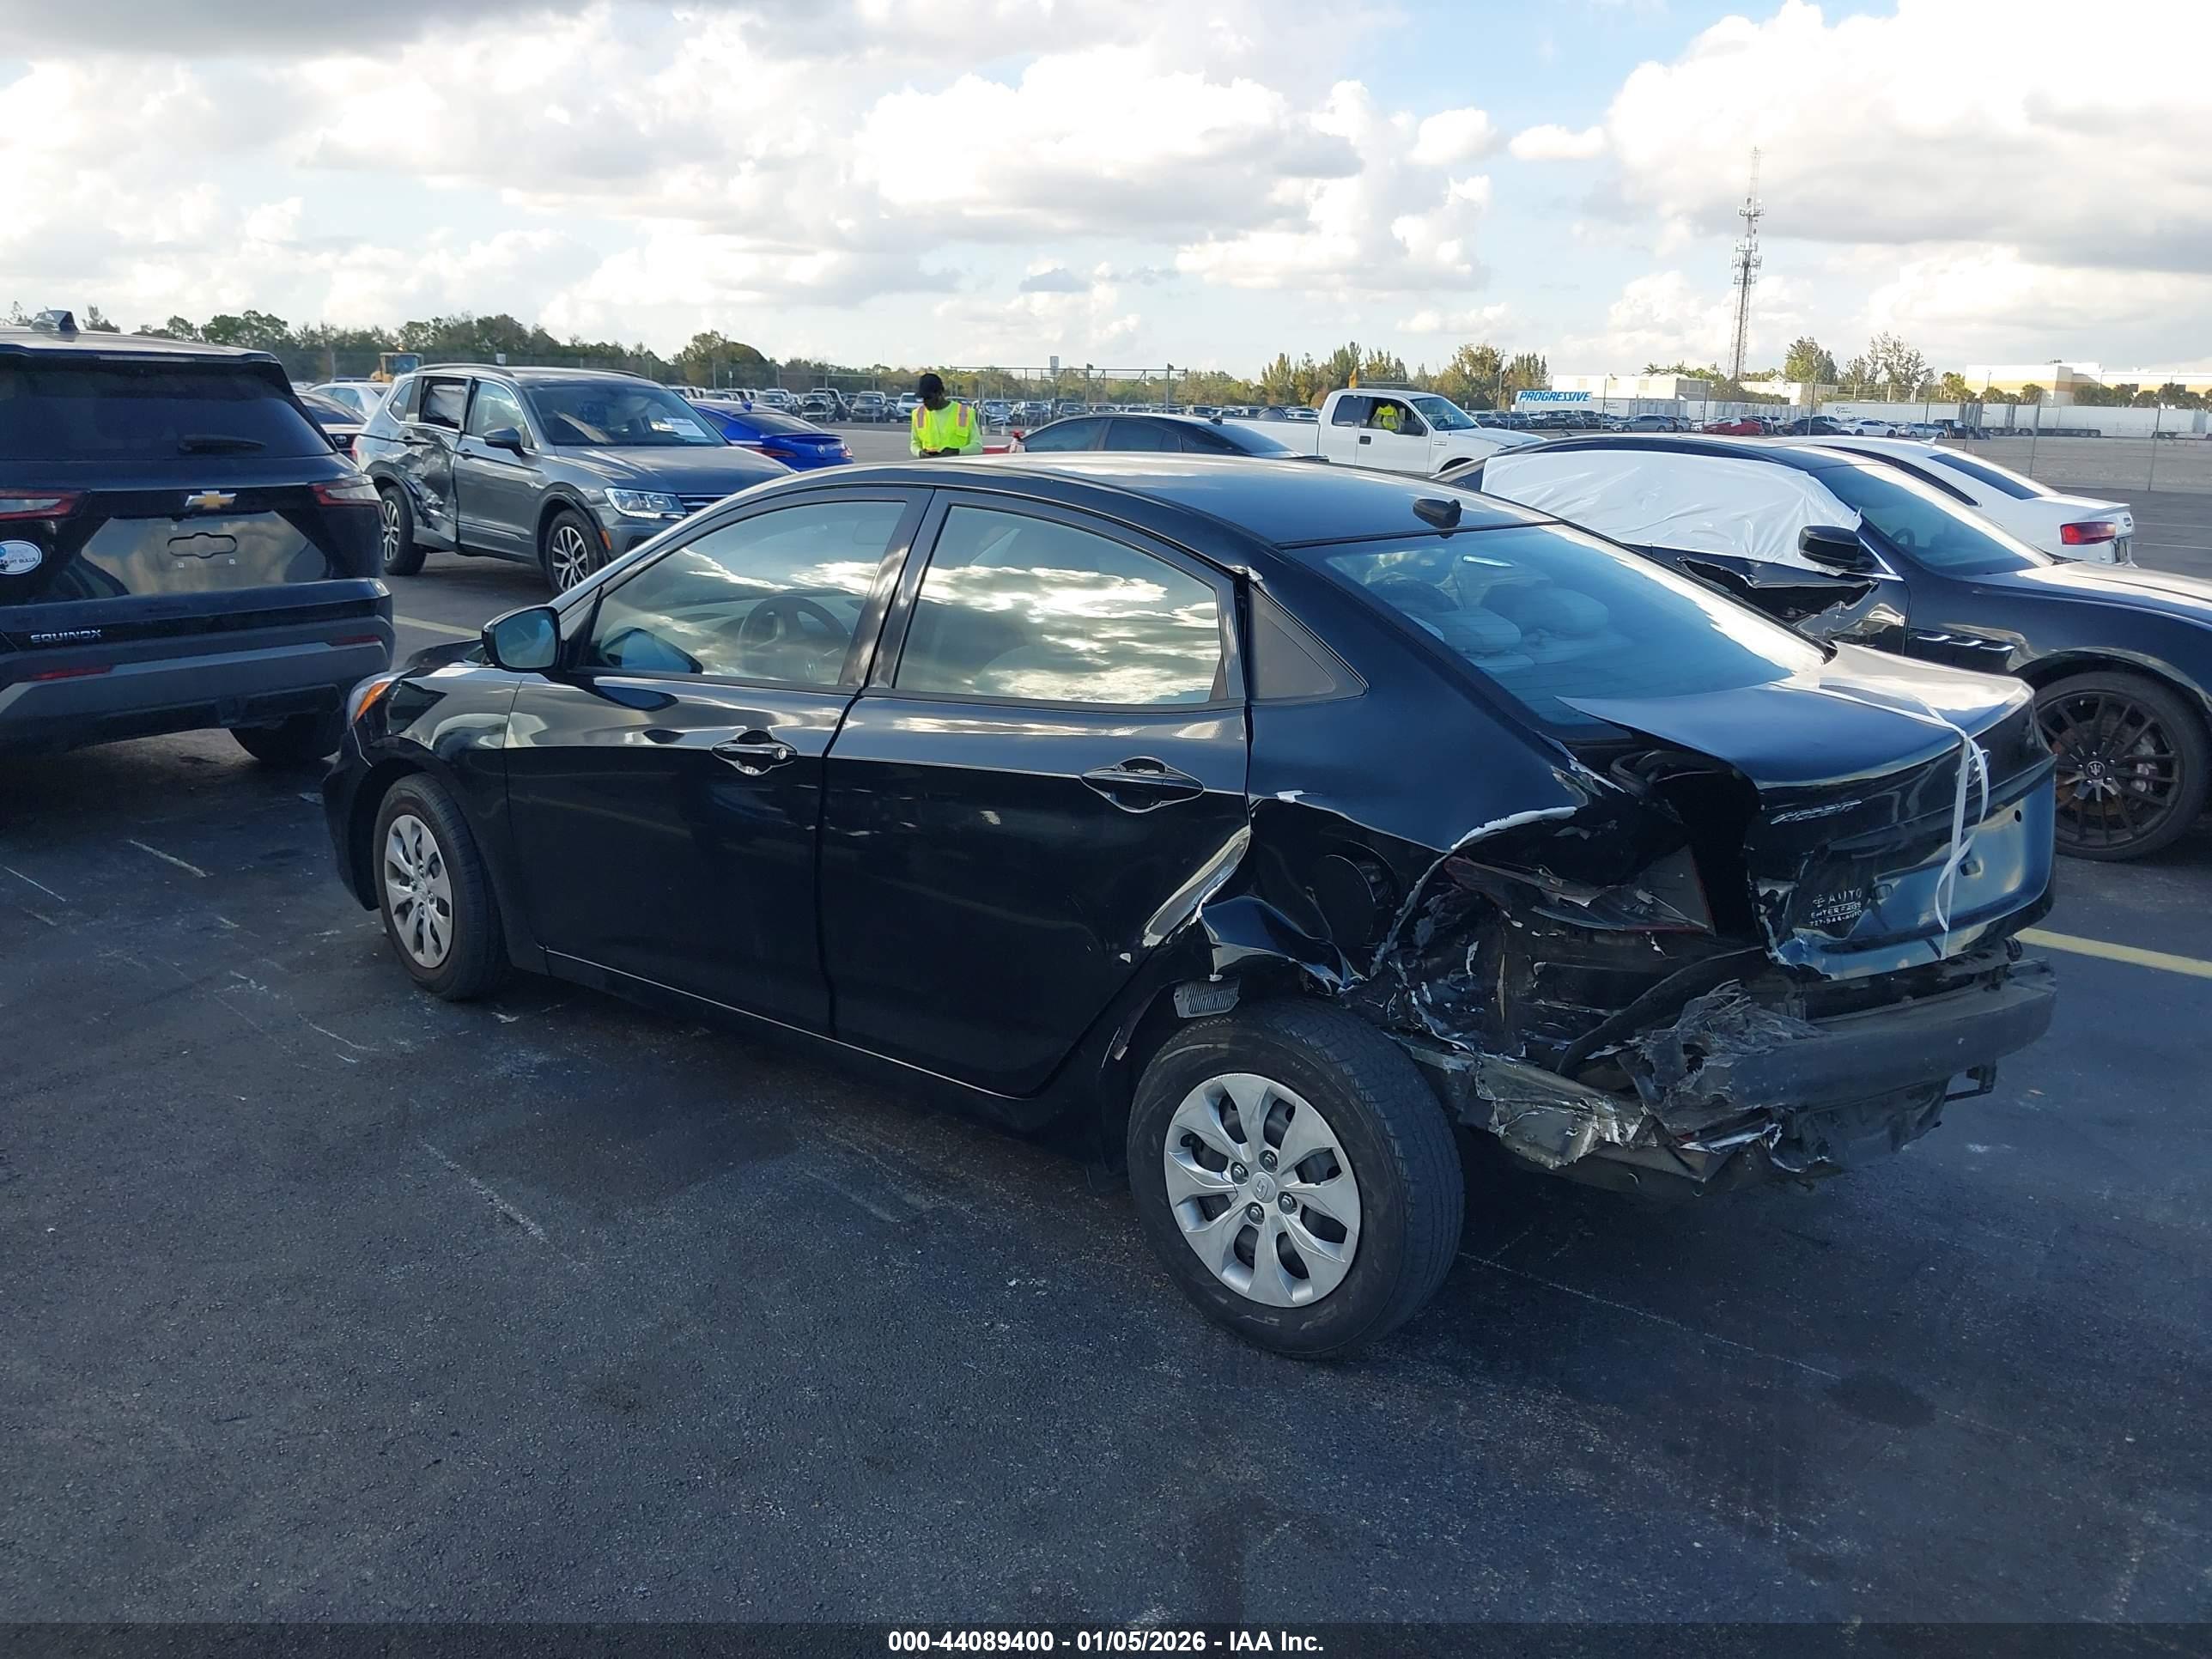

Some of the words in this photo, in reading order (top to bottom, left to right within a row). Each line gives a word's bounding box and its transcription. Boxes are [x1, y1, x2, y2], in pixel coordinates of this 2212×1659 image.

[1519, 392, 1593, 401] PROGRESSIVE
[30, 629, 102, 643] EQUINOX
[1828, 887, 1862, 903] AUTO
